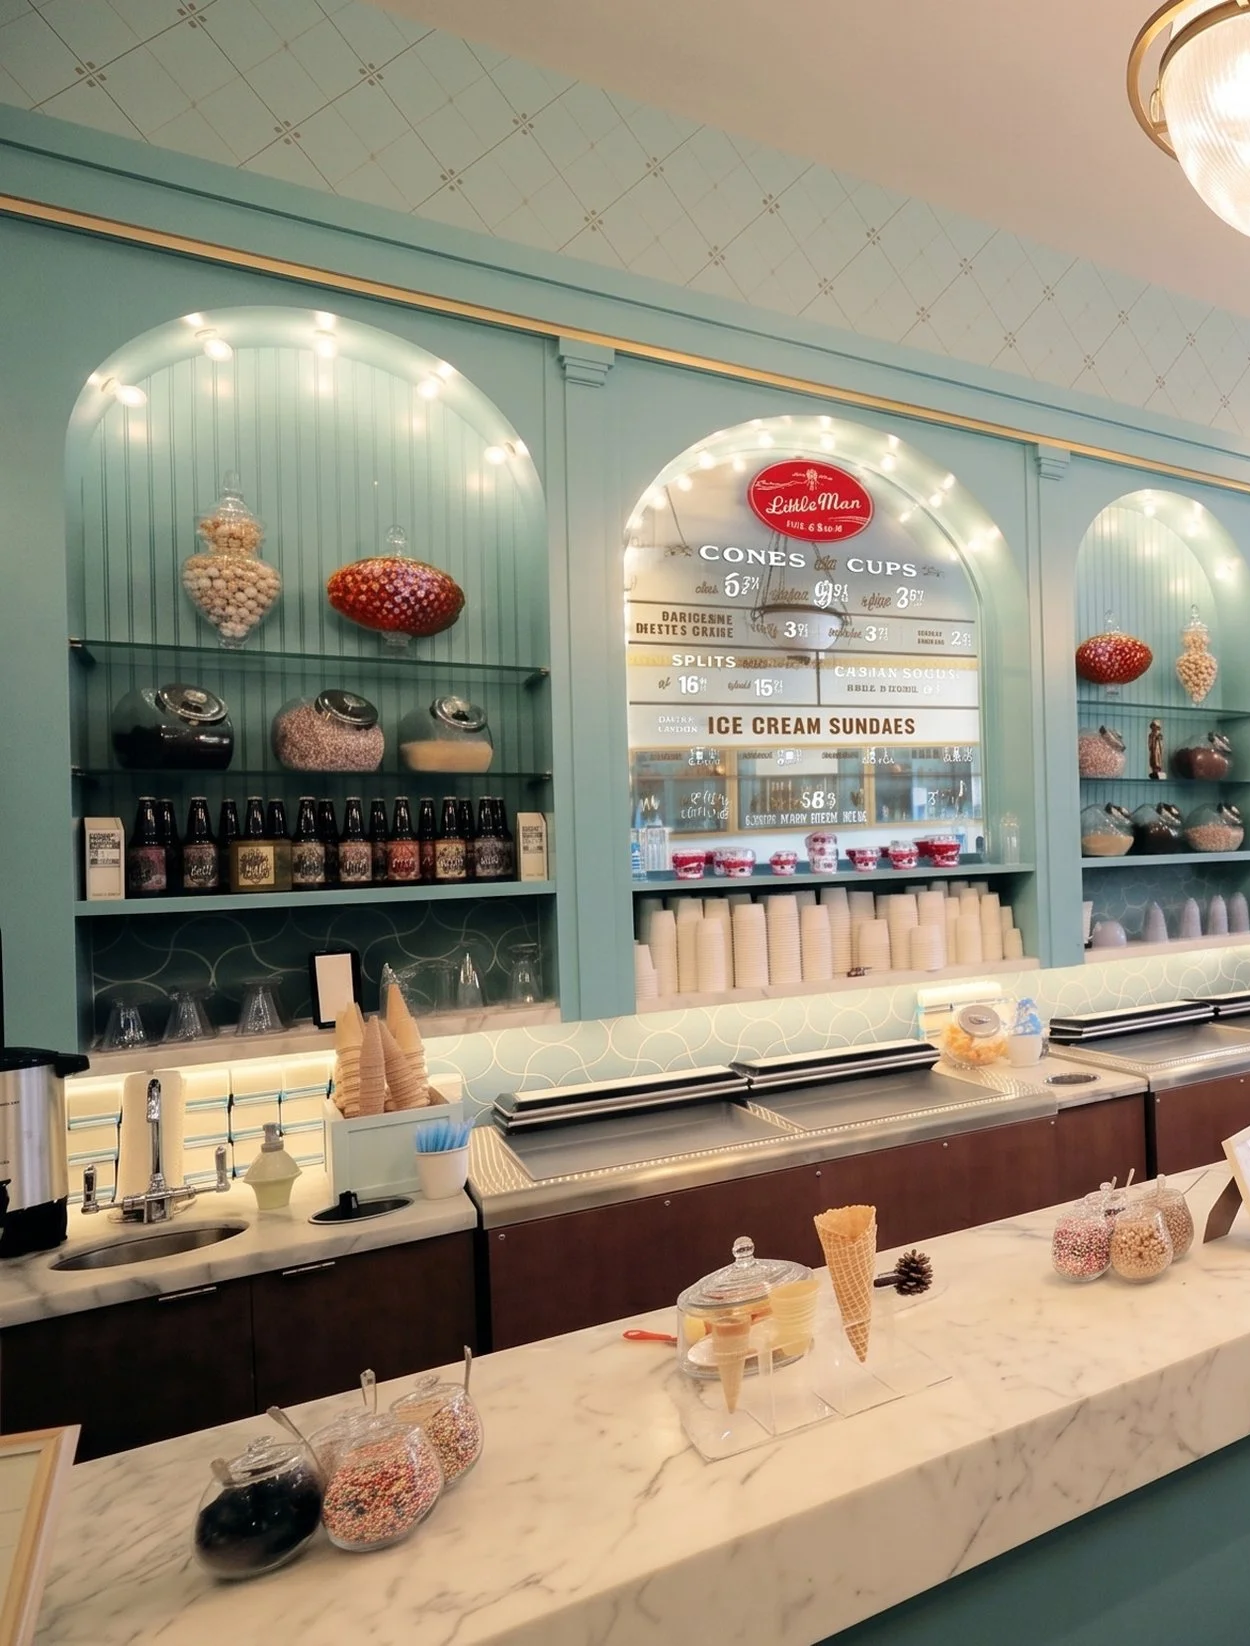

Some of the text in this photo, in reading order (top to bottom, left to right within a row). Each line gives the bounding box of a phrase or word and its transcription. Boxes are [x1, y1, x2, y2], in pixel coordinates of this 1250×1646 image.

[818, 492, 861, 510] Man
[699, 545, 806, 568] CONES
[846, 558, 917, 578] CUPS
[671, 654, 737, 668] SPLITS
[708, 716, 915, 735] ICE CREAM SUNDAES
